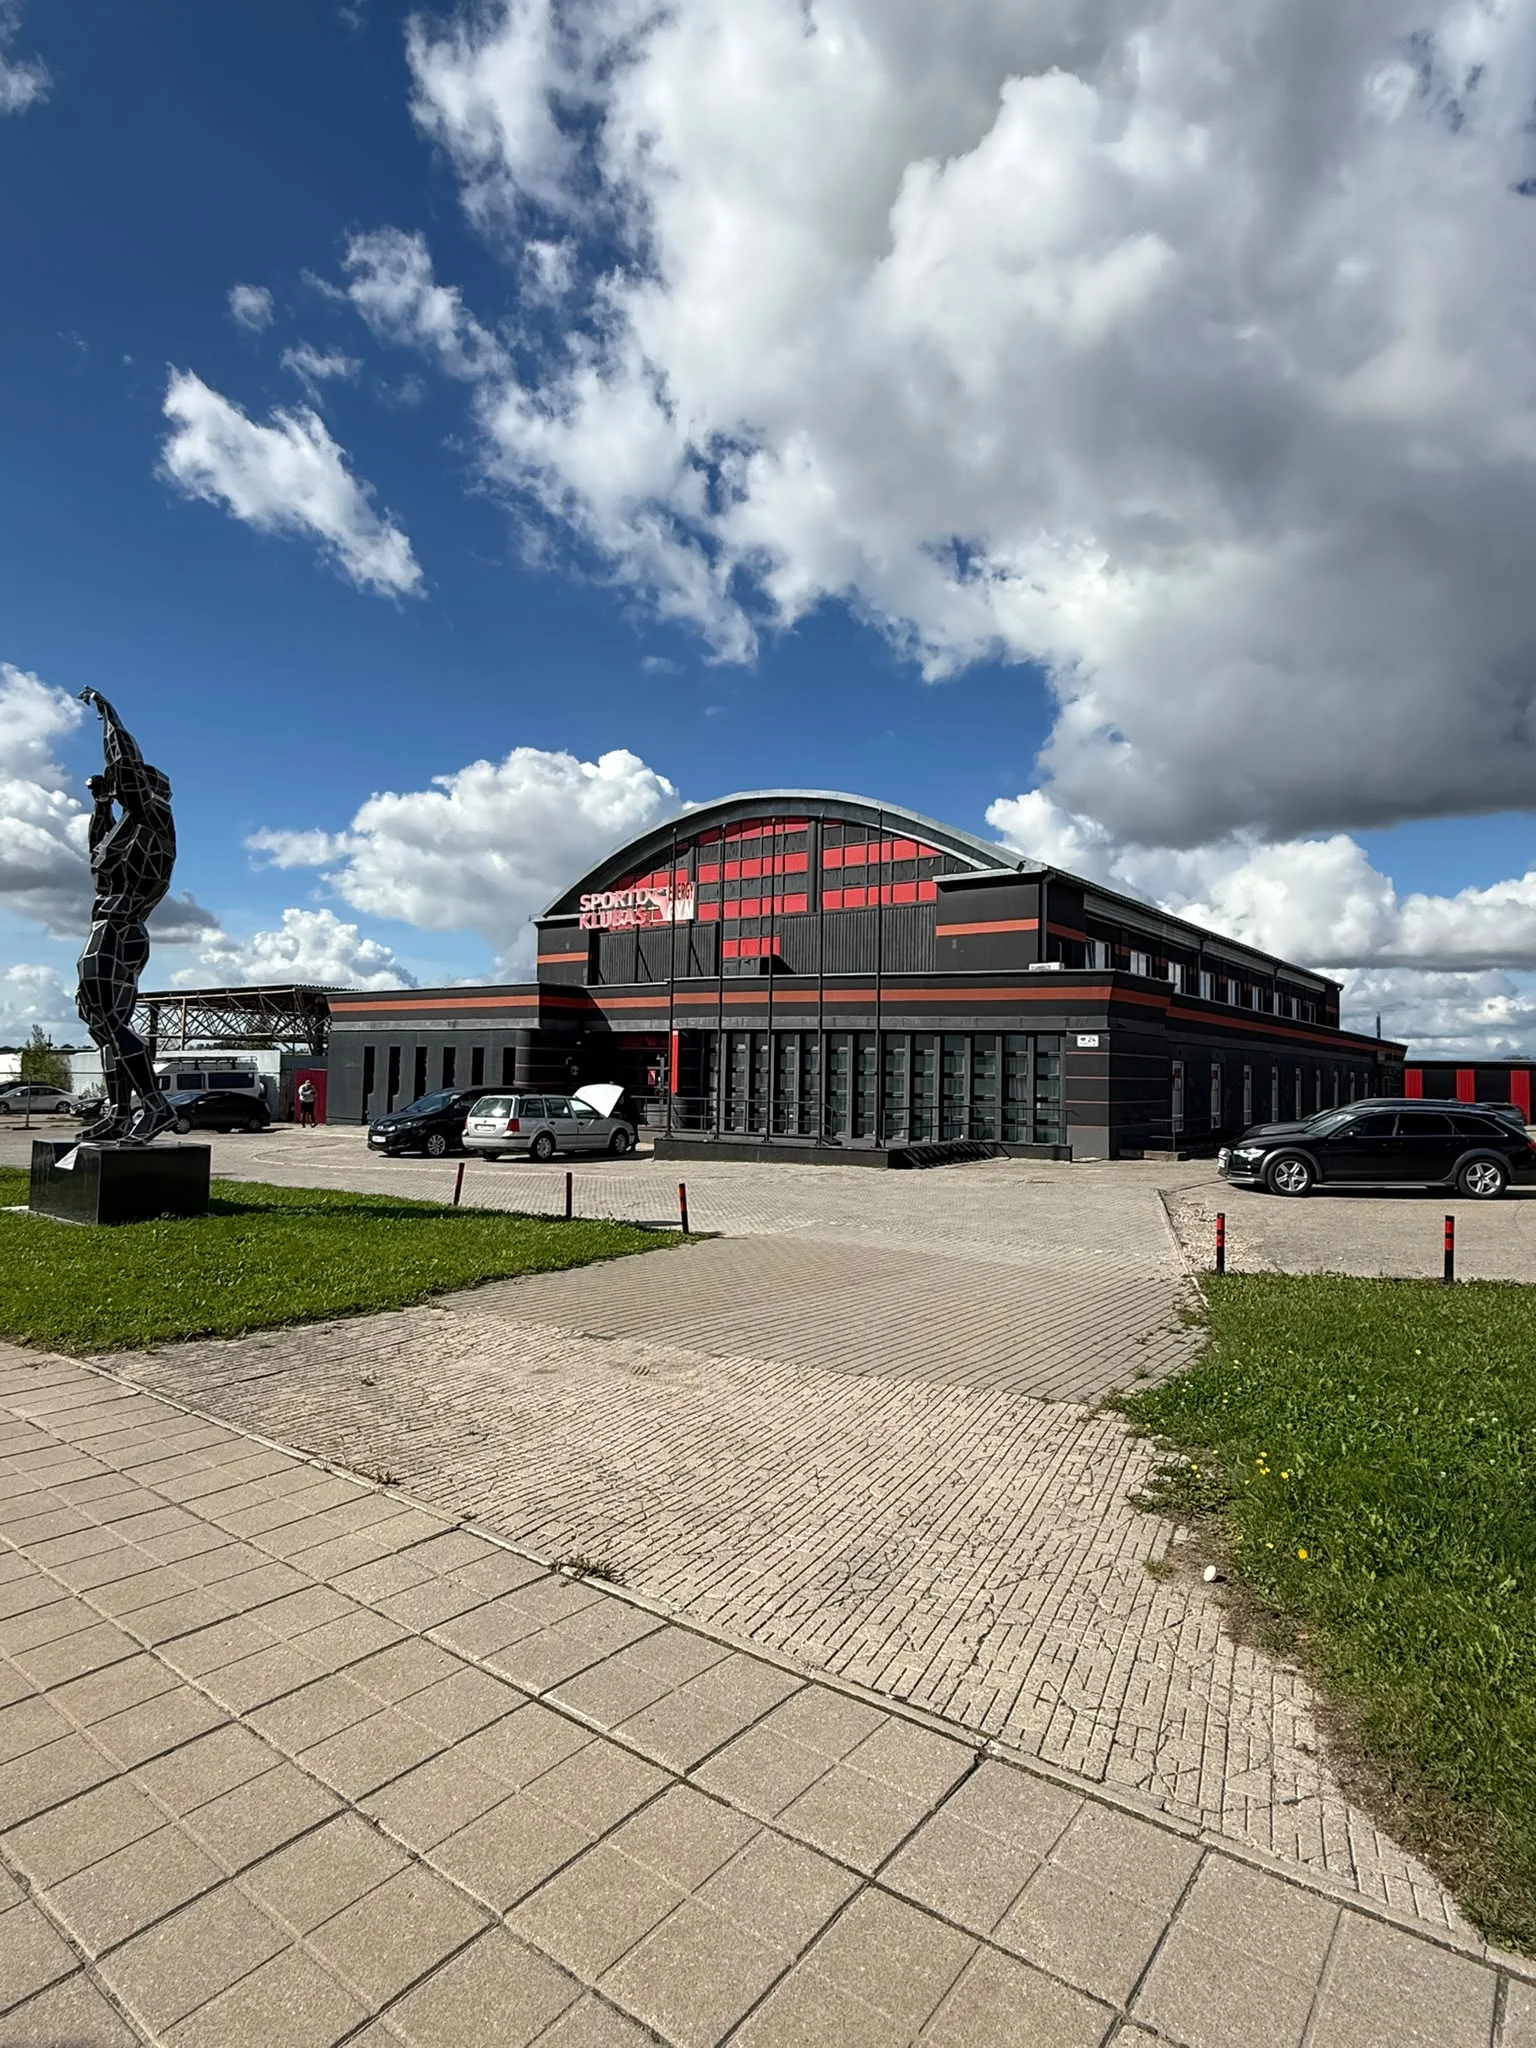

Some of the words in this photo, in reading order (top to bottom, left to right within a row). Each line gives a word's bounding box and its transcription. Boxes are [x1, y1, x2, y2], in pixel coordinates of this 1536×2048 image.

[579, 888, 648, 912] SPORTO
[668, 881, 694, 901] EERGY
[579, 905, 646, 930] KLUBAS
